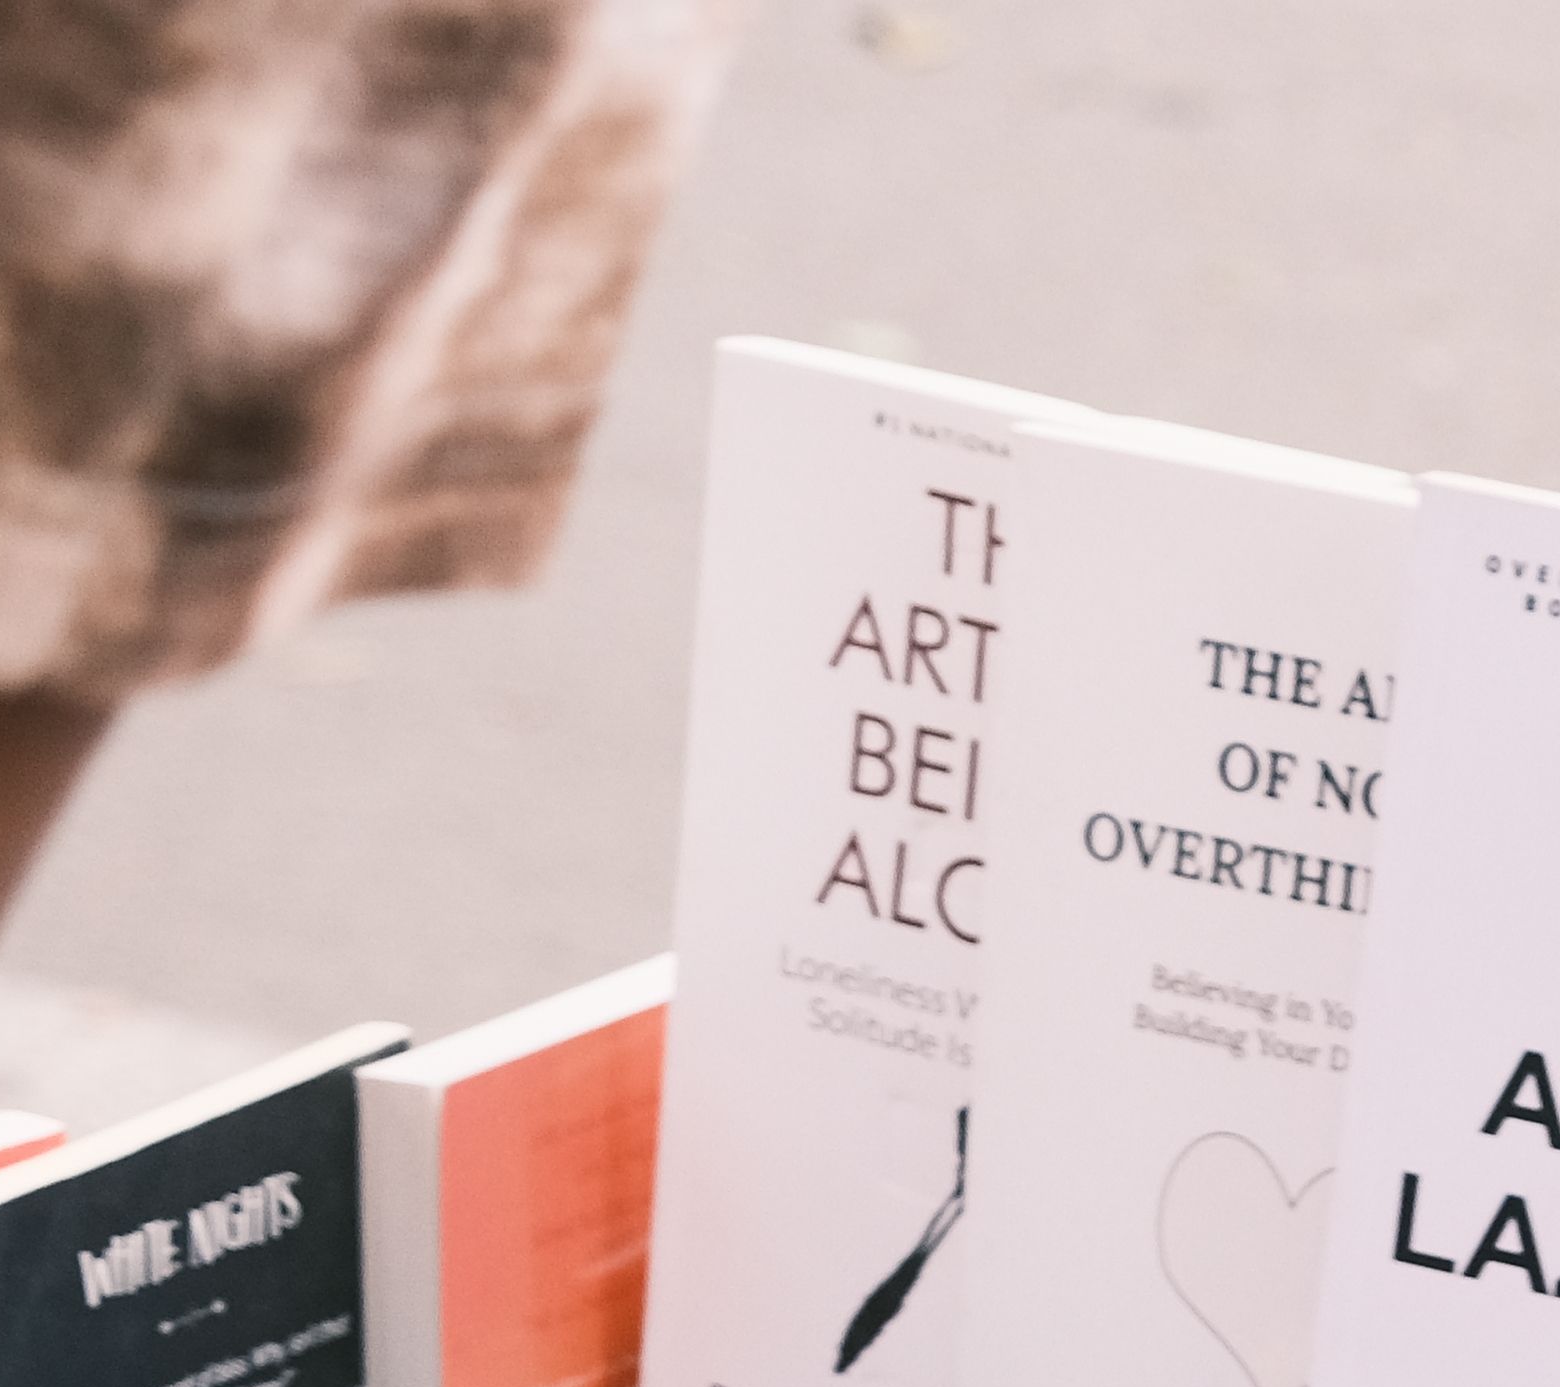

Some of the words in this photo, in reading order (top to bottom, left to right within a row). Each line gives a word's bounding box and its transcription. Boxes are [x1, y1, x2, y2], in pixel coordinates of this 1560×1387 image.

[828, 594, 1000, 702] ART
[1199, 638, 1321, 707] THE
[1217, 741, 1297, 802] OF
